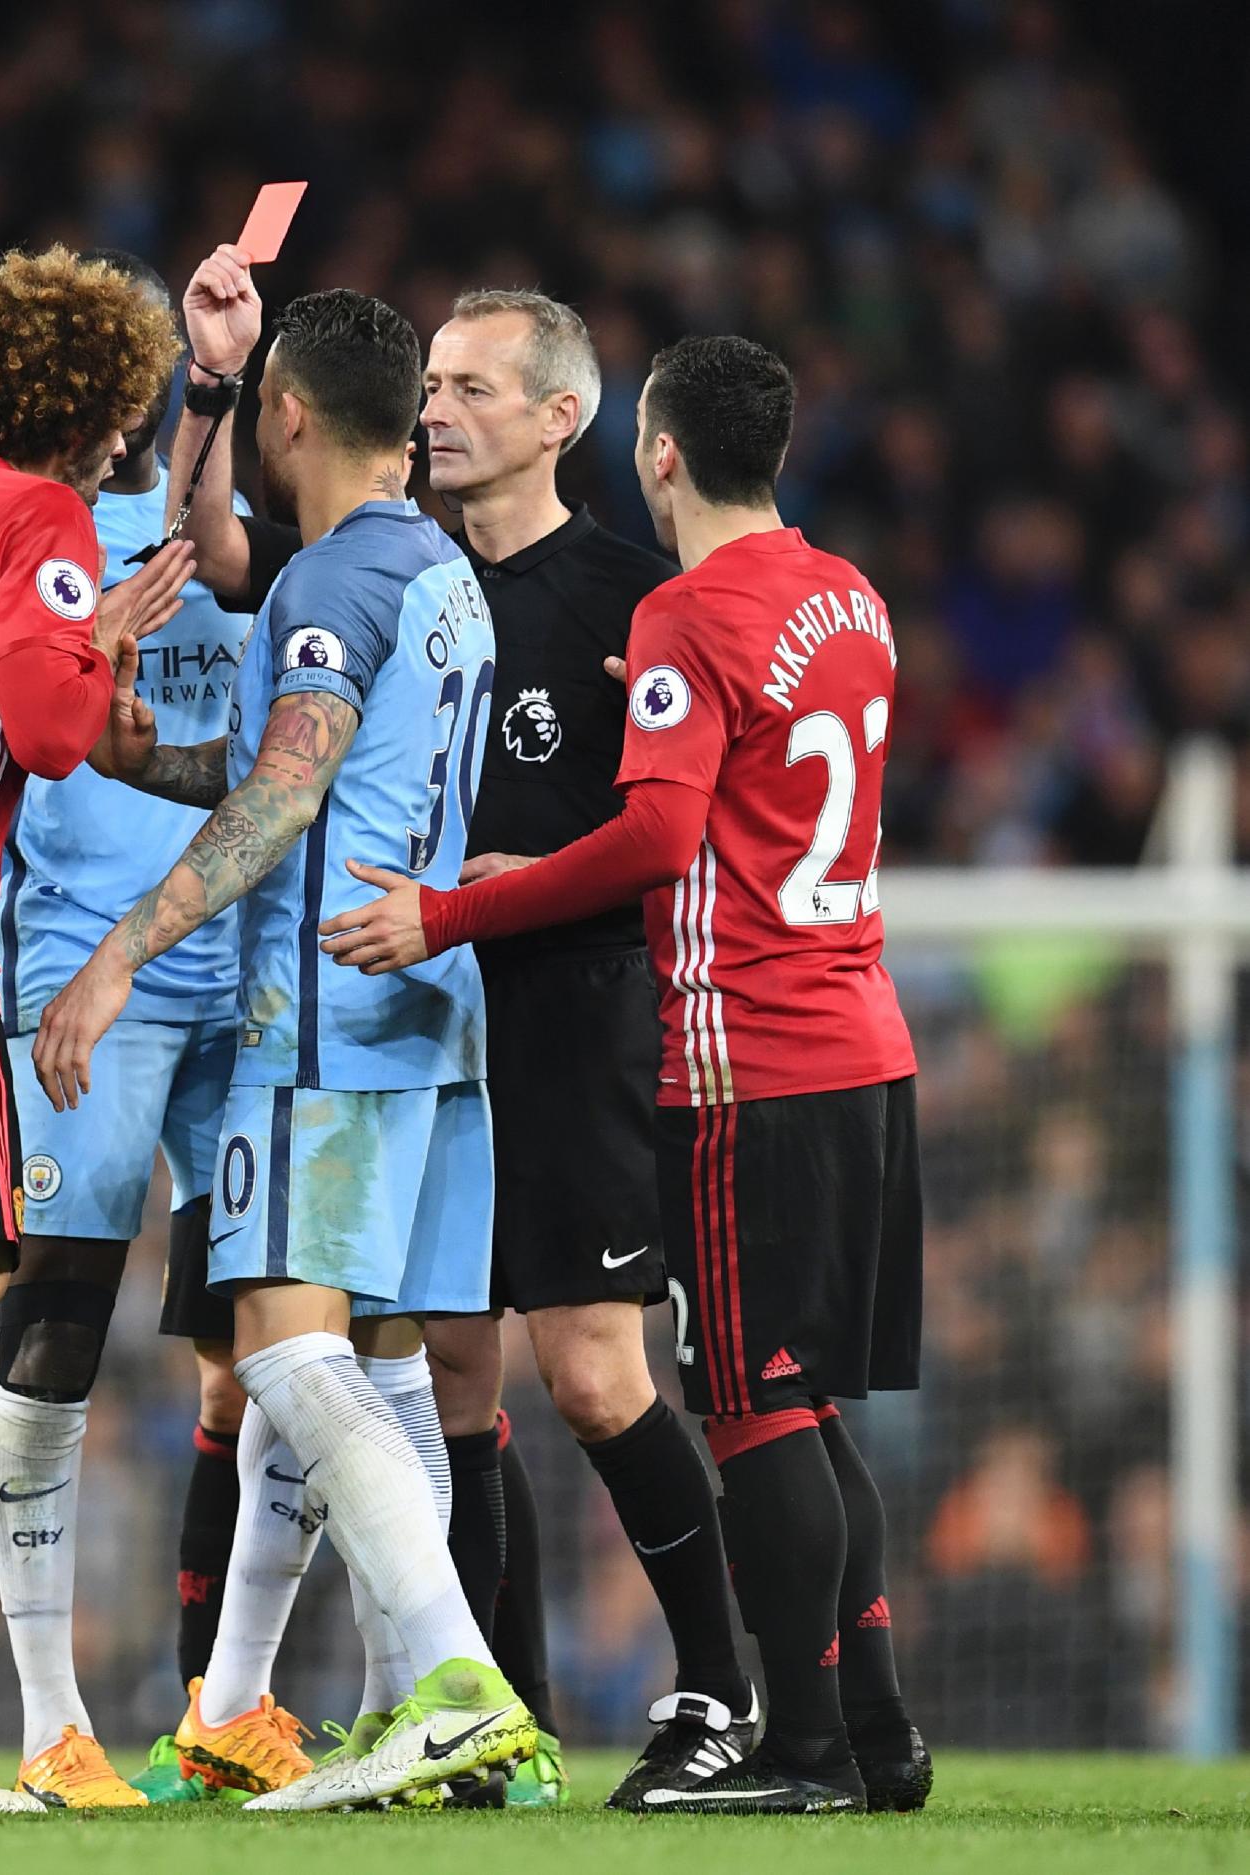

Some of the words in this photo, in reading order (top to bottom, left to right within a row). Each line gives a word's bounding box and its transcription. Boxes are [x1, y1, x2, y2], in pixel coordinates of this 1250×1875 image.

[222, 1133, 257, 1218] 0
[762, 1364, 801, 1379] adidas
[12, 1527, 64, 1548] City
